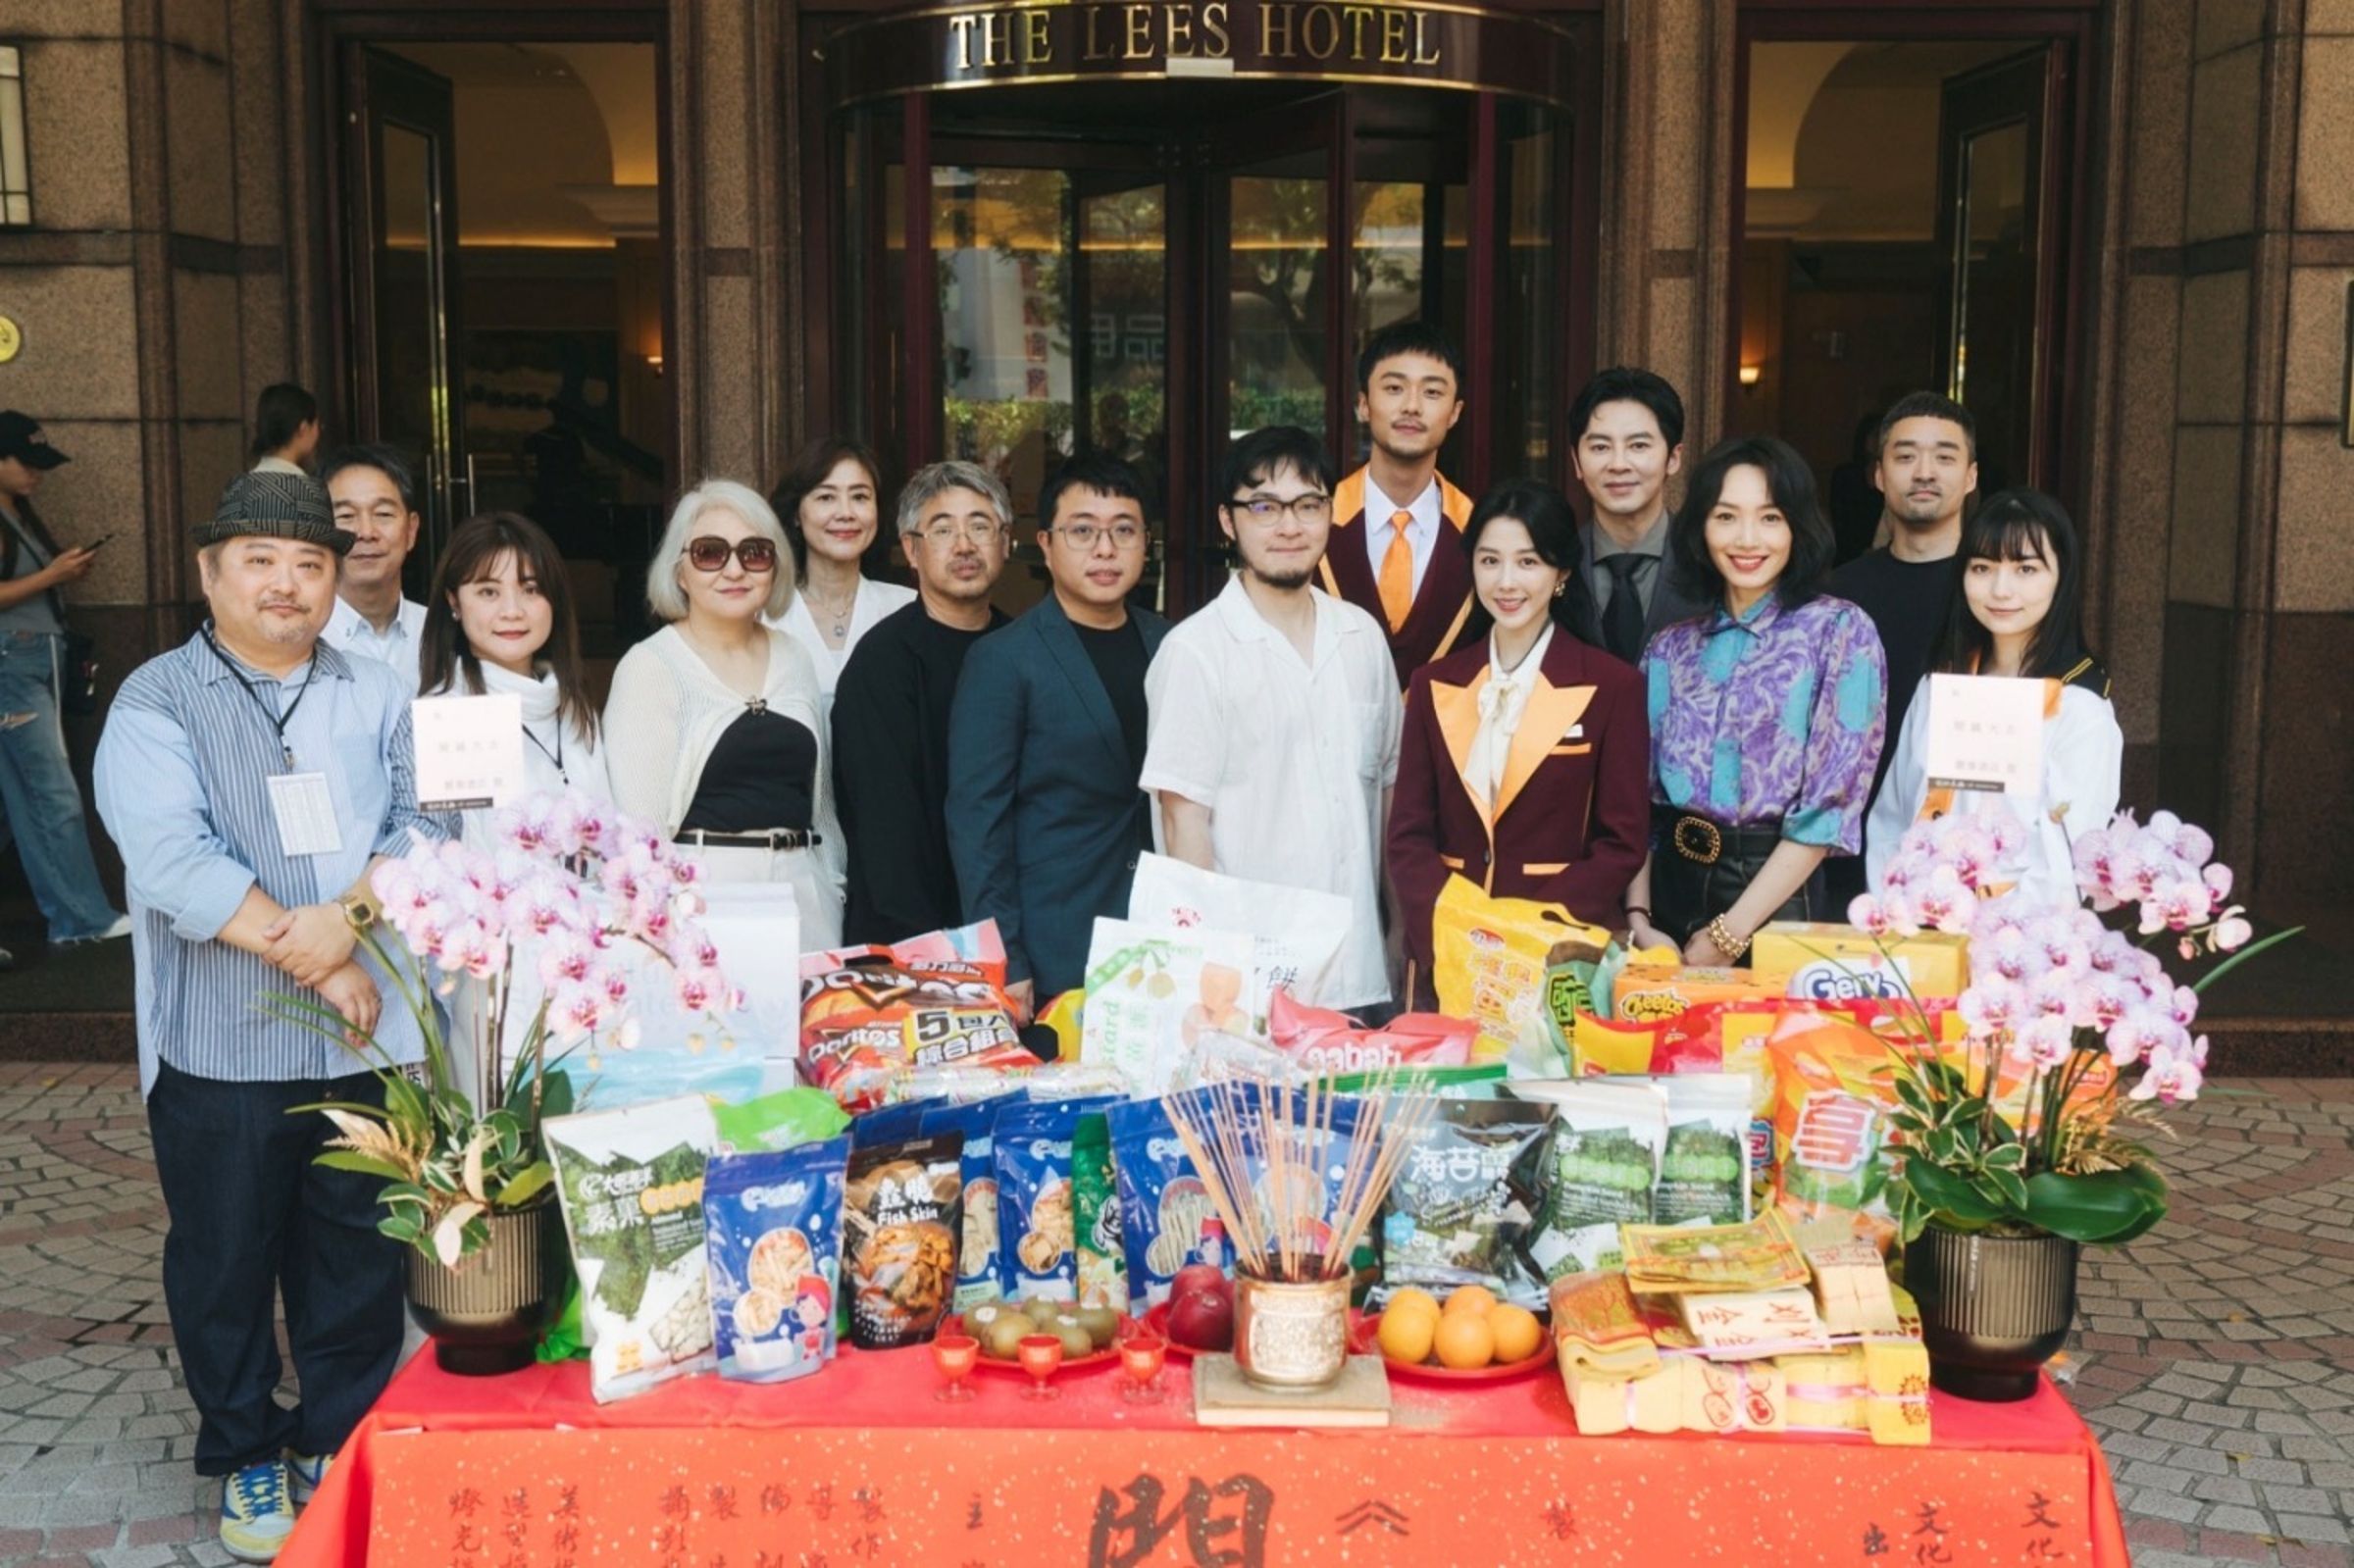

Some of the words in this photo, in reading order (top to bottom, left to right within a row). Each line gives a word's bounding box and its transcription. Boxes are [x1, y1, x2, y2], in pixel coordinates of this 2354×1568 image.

[949, 10, 1052, 70] THE
[1083, 3, 1230, 60] LEES
[1258, 3, 1441, 66] HOTEL
[807, 1027, 901, 1065] Doritos
[916, 1011, 950, 1042] 5
[1409, 1144, 1480, 1184] 海苔
[909, 1204, 939, 1222] Skin
[1862, 1523, 1891, 1558] 出
[1913, 1502, 1953, 1566] 文化
[2021, 1491, 2064, 1560] 文化
